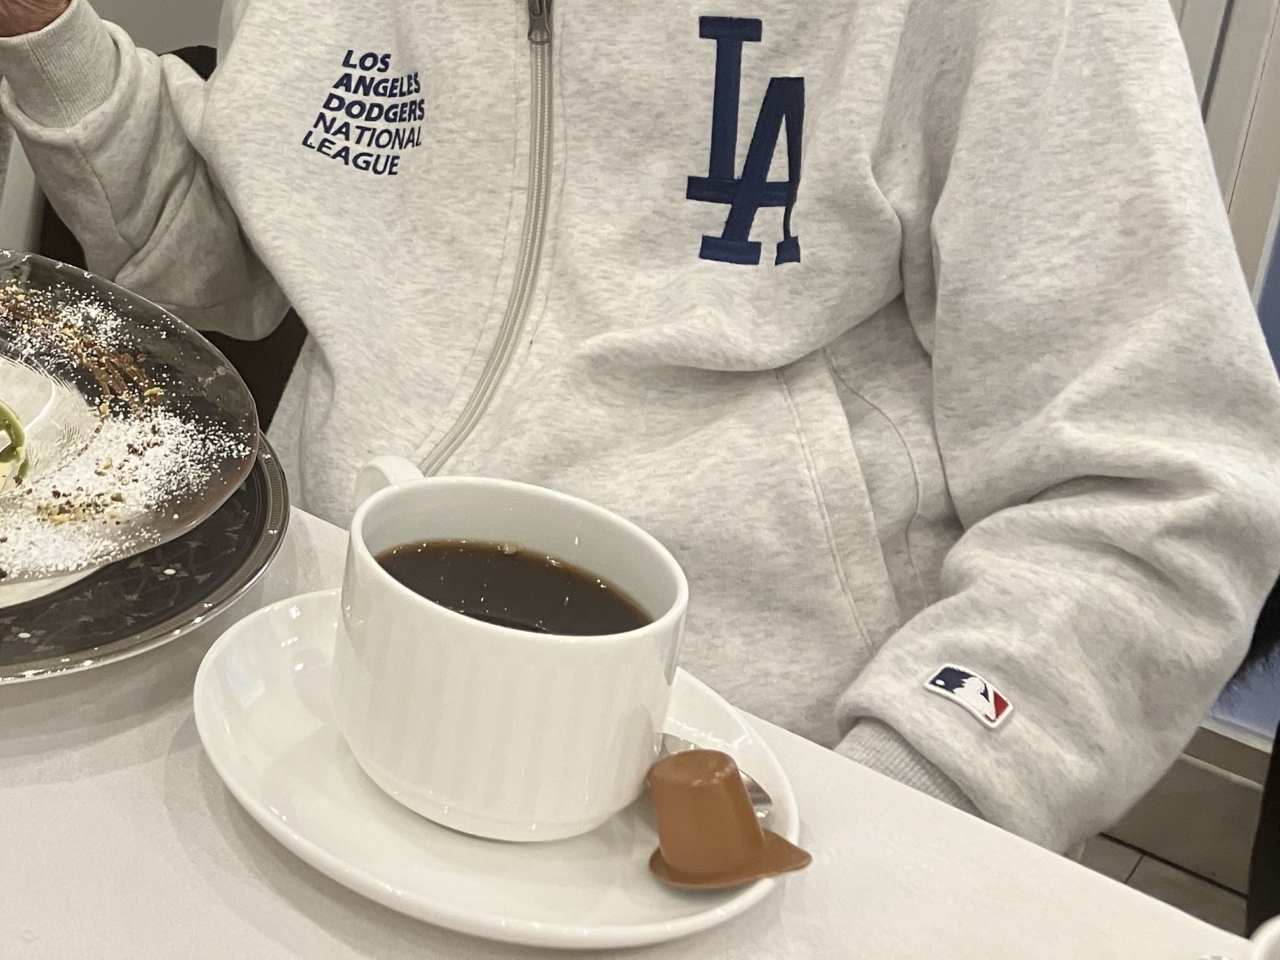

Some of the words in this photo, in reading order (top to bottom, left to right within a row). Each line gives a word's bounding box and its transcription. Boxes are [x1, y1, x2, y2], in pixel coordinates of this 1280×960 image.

[341, 49, 392, 73] LOS
[332, 71, 422, 98] ANGELES
[322, 92, 425, 123] DODGERS
[313, 111, 422, 150] NATIONAL
[686, 15, 805, 266] LA
[301, 130, 401, 176] LEAGUE
